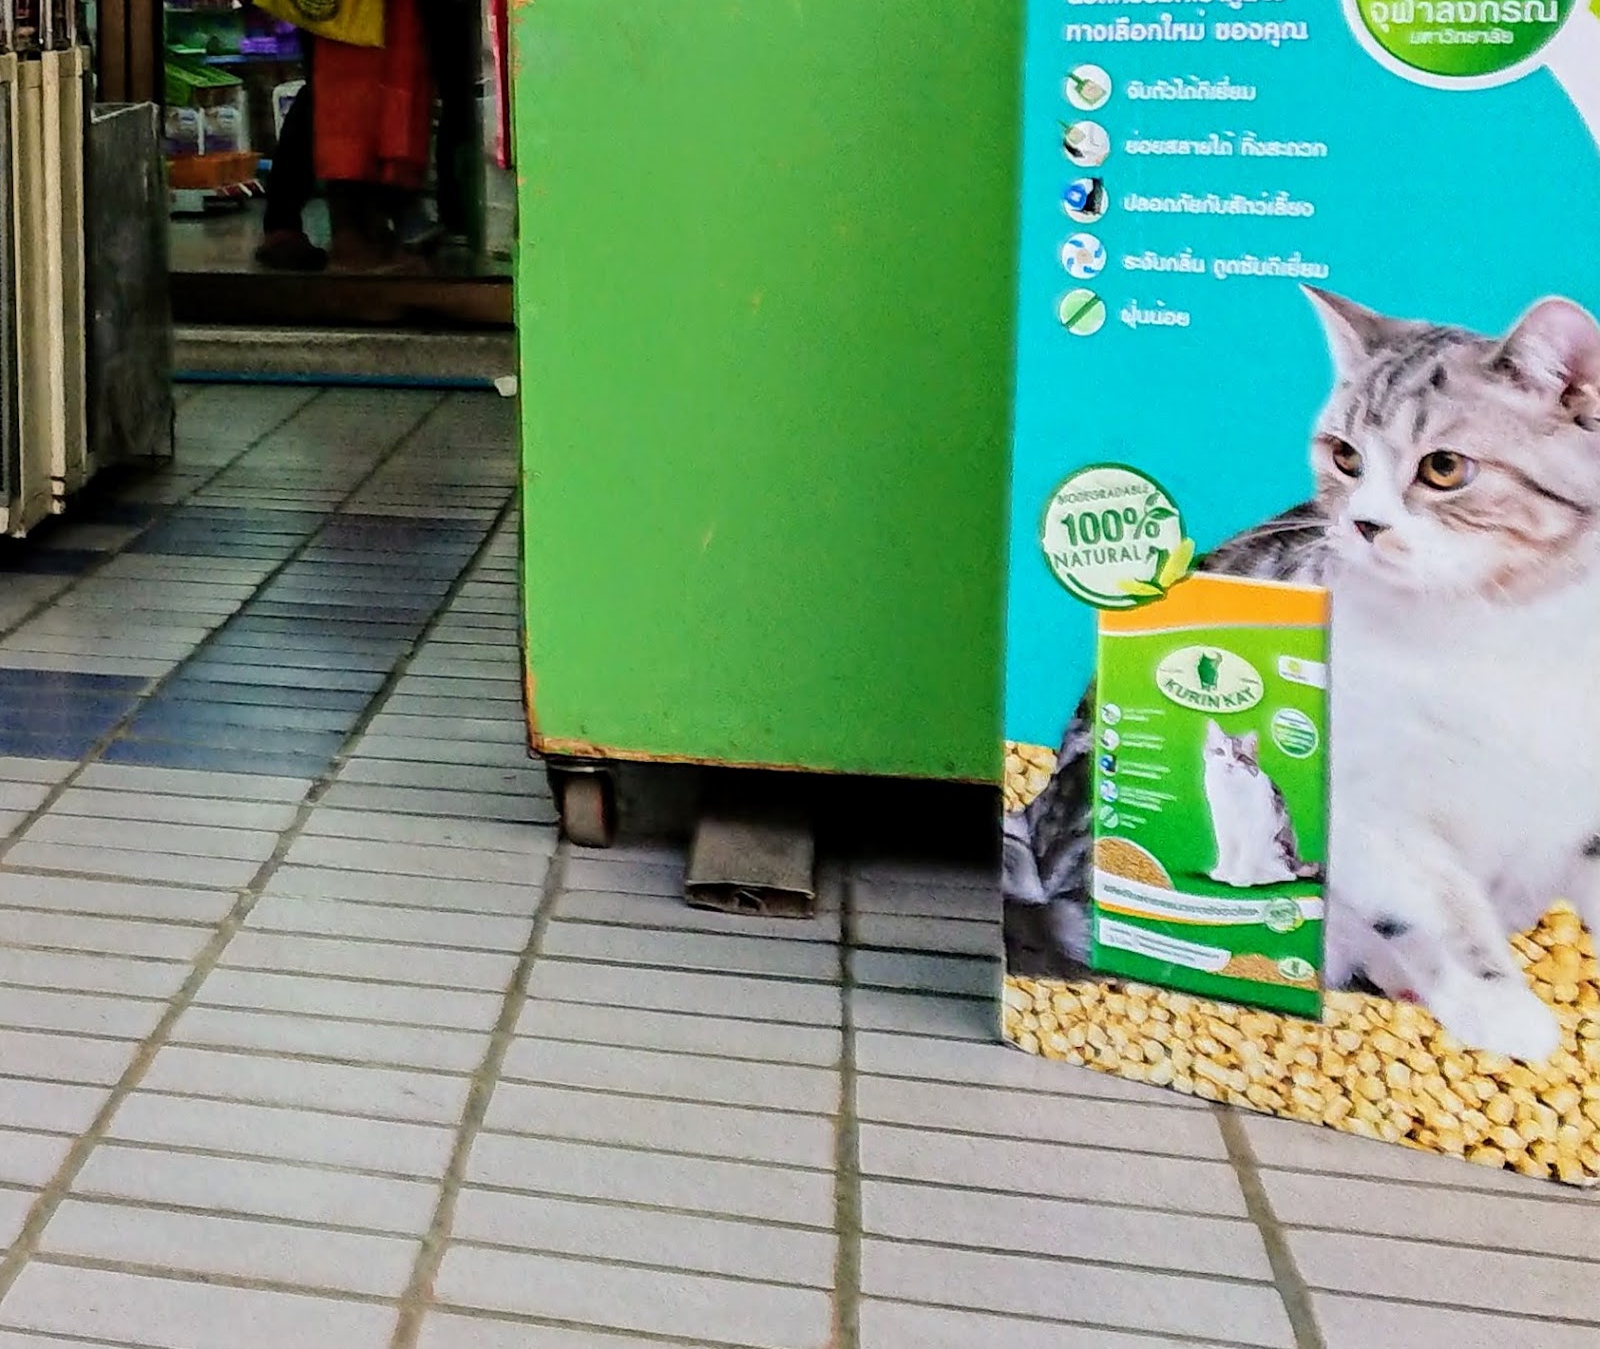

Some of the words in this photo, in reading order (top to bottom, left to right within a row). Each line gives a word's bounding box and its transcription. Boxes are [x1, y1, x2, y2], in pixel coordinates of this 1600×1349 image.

[1066, 8, 1206, 42] ทางเลือกใหม่
[1215, 21, 1310, 49] ของคุณ
[1060, 506, 1162, 547] 100%
[1052, 545, 1143, 570] NATURAL
[1165, 677, 1221, 709] KURIN
